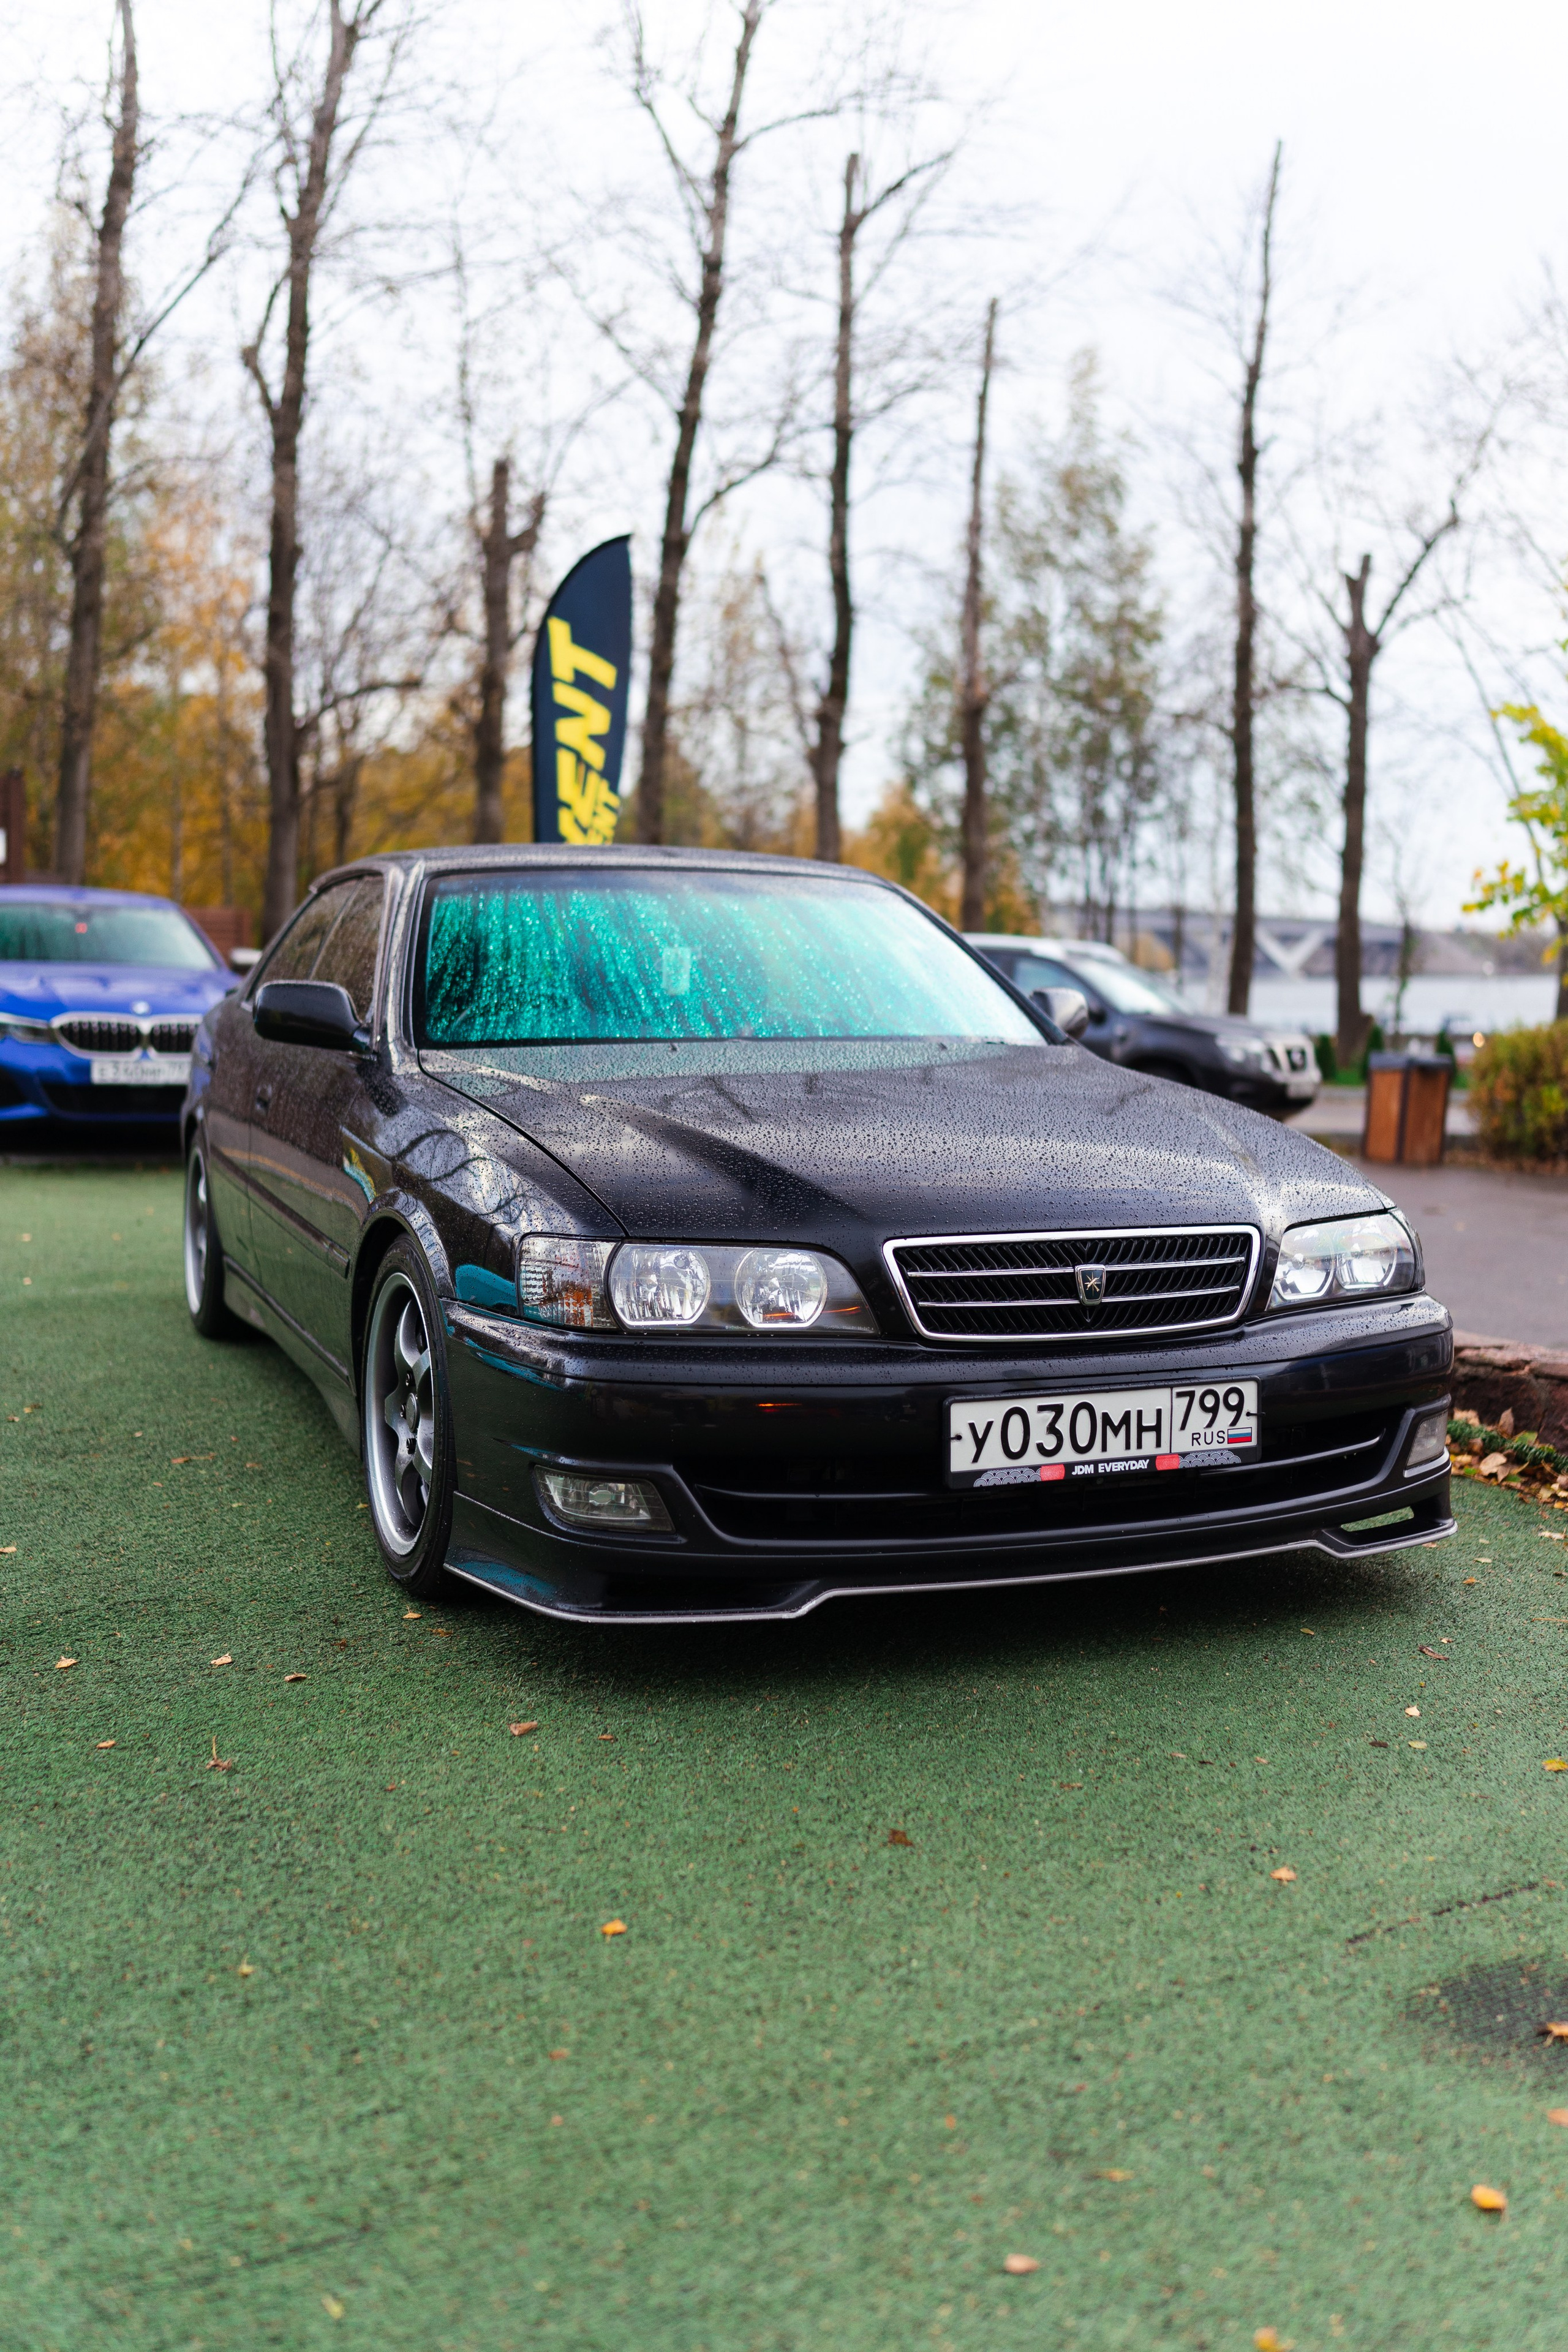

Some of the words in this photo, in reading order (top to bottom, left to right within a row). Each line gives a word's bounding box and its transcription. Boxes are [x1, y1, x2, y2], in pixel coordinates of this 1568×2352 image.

[968, 1401, 1163, 1463] У030МН
[1175, 1386, 1245, 1431] 799
[1191, 1430, 1226, 1447] RUS
[1071, 1464, 1094, 1476] JDM
[1098, 1459, 1150, 1473] EVERYDAY
